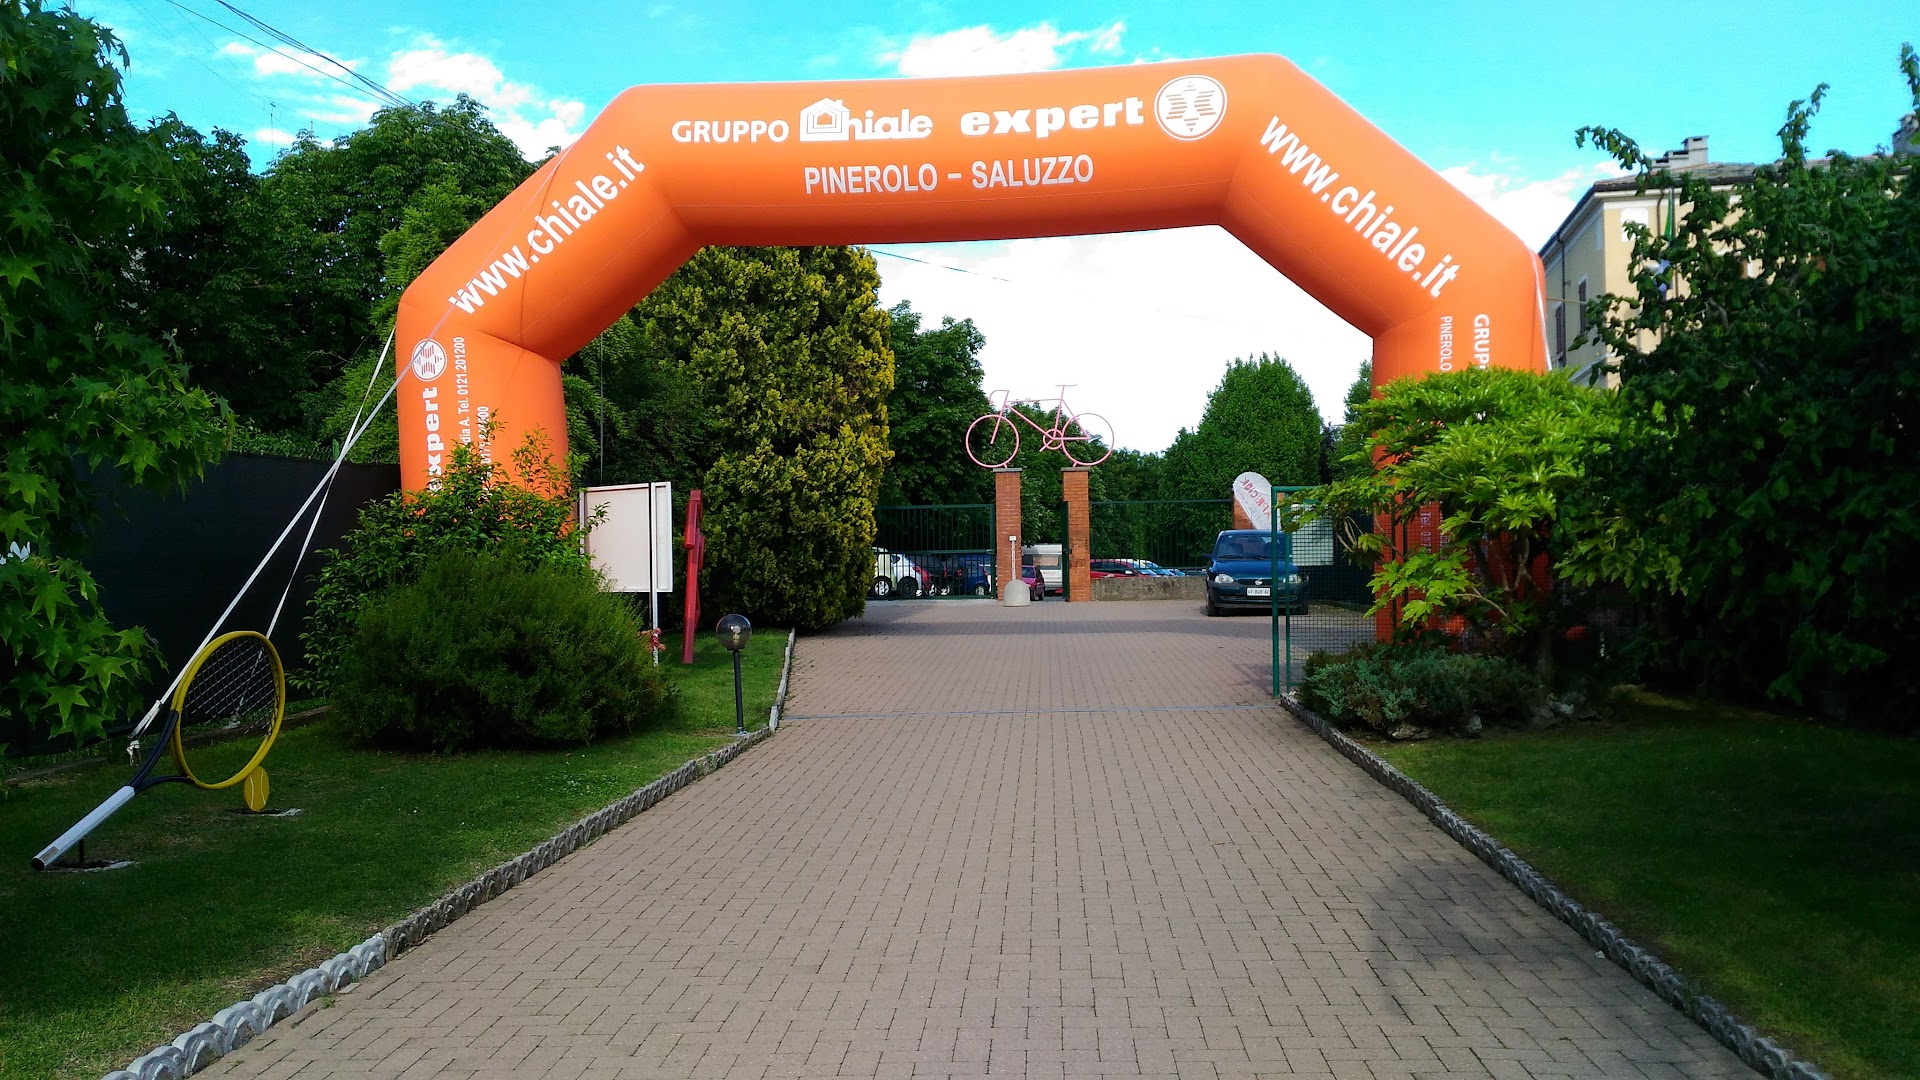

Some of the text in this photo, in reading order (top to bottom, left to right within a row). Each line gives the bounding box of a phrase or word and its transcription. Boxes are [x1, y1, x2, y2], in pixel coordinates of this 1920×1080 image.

[671, 119, 790, 143] GRUPPO
[960, 96, 1144, 138] expert
[804, 163, 938, 195] PINEROLO
[971, 154, 1094, 189] SALUZZO
[448, 144, 645, 314] www.chiale.it
[1260, 115, 1461, 298] www.chiale.it
[452, 336, 469, 396] 0121.201200
[1440, 315, 1453, 371] PINEROLO
[1474, 313, 1490, 369] GRUP
[457, 397, 470, 415] Tel.
